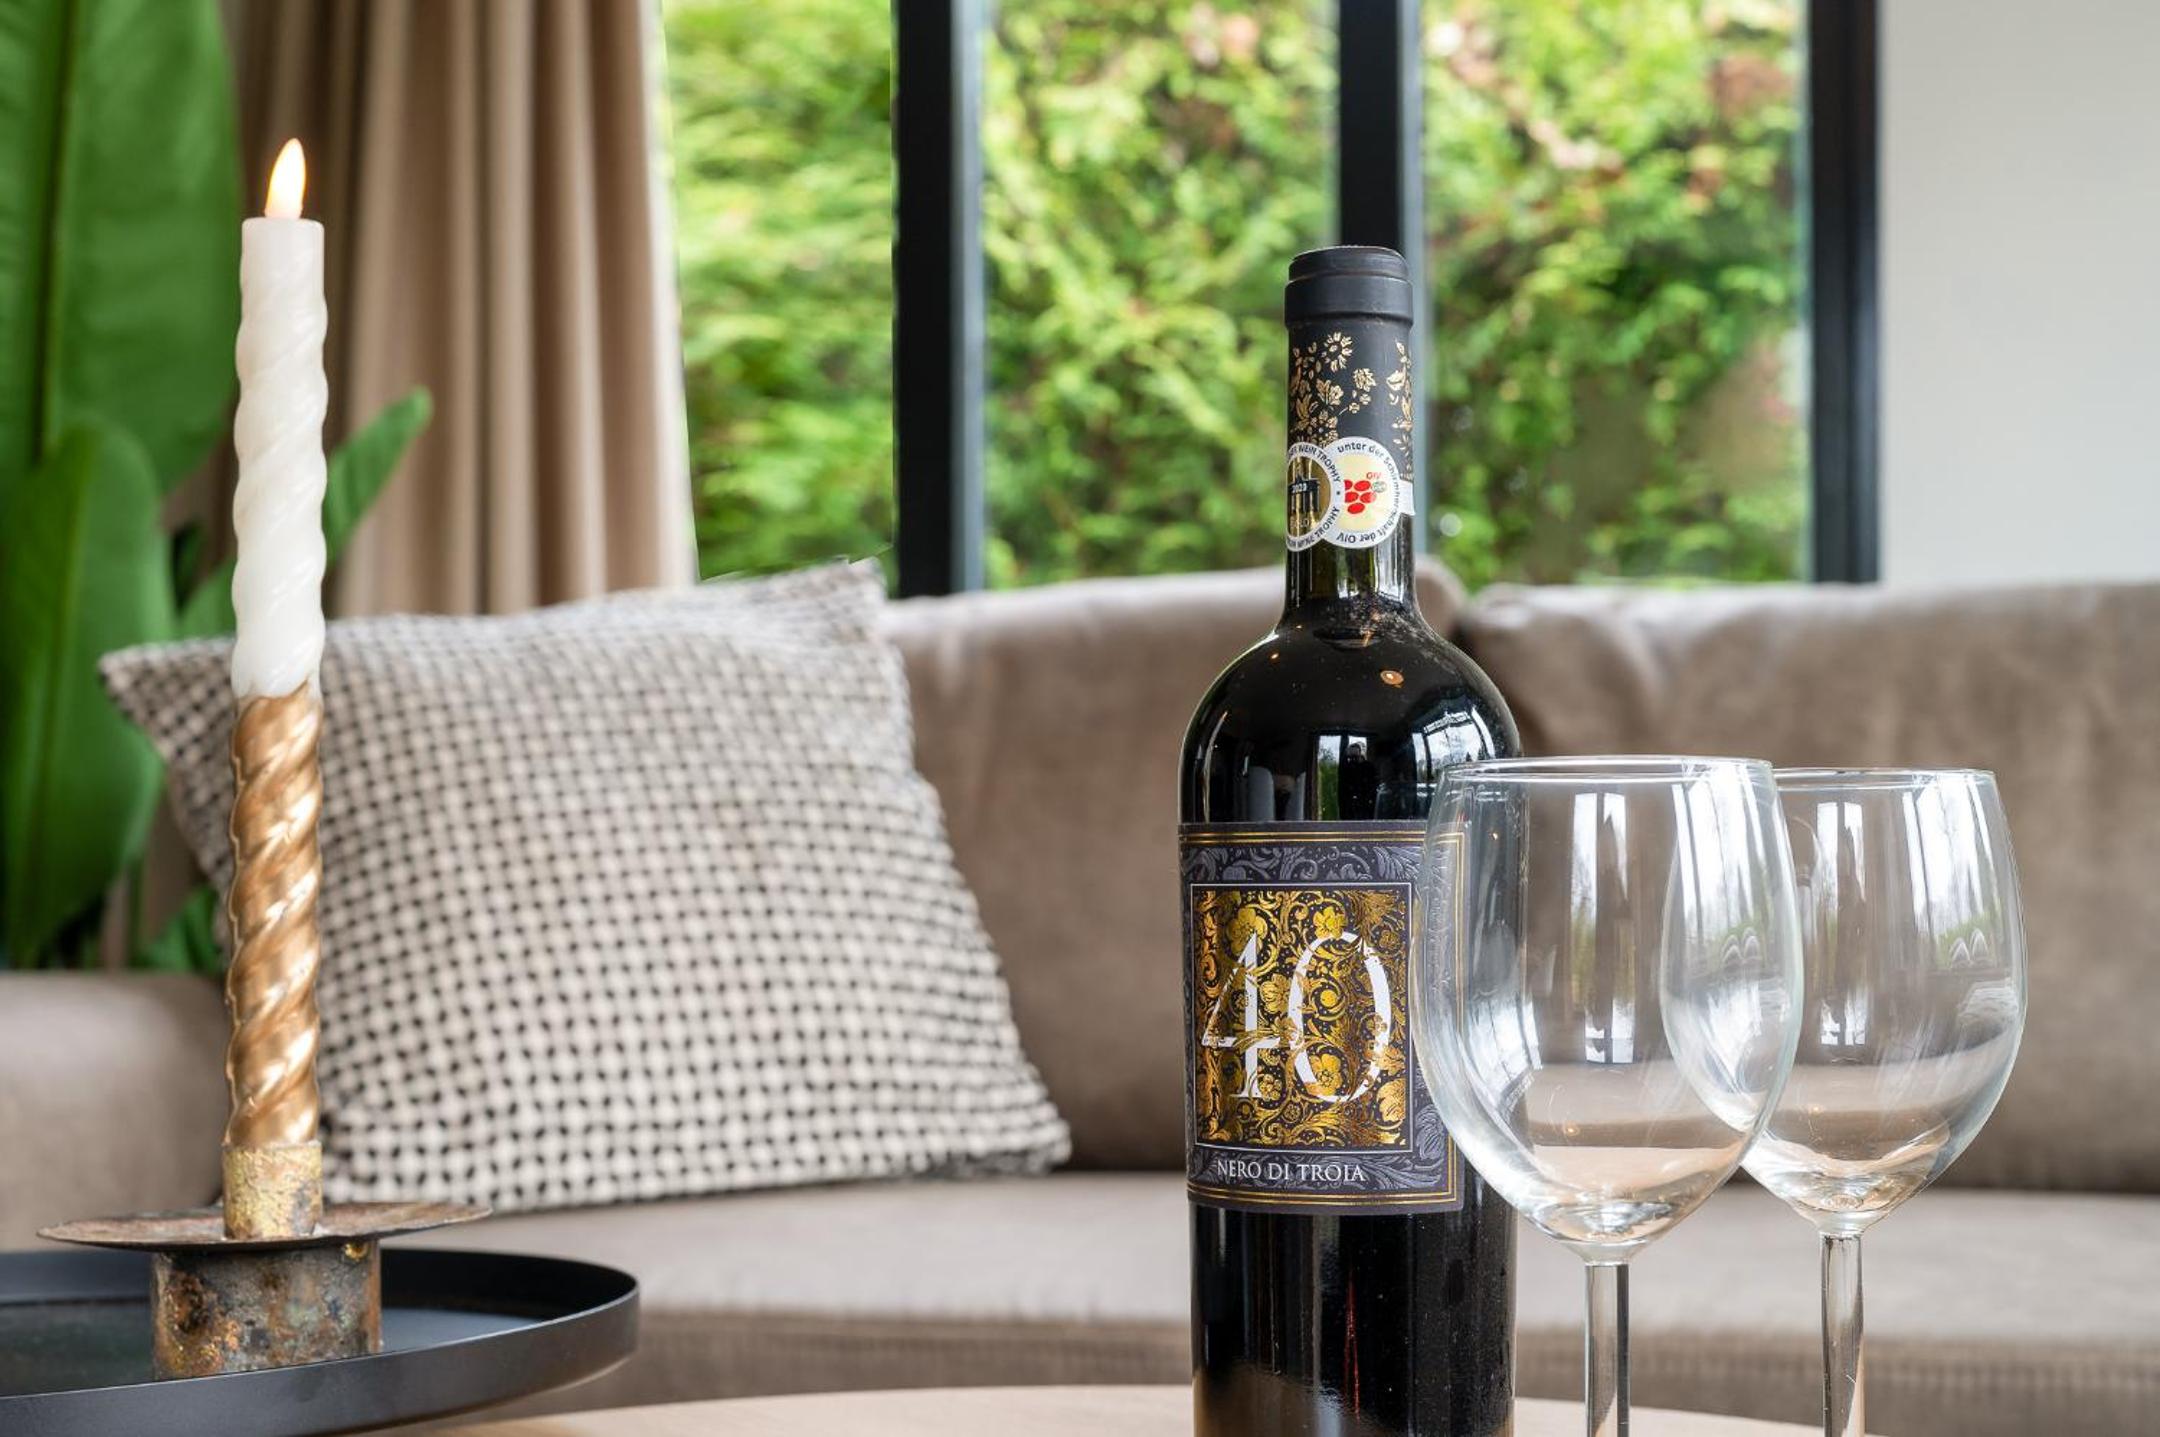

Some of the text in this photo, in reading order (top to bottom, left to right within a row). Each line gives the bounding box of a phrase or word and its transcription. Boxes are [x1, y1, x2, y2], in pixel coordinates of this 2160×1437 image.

[1317, 451, 1341, 483] TROPHY
[1314, 506, 1340, 539] TROPHY
[1336, 532, 1356, 543] OIV
[1359, 532, 1376, 543] der
[1201, 930, 1392, 1101] 40
[1217, 1159, 1366, 1182] NERO DI TROIA
